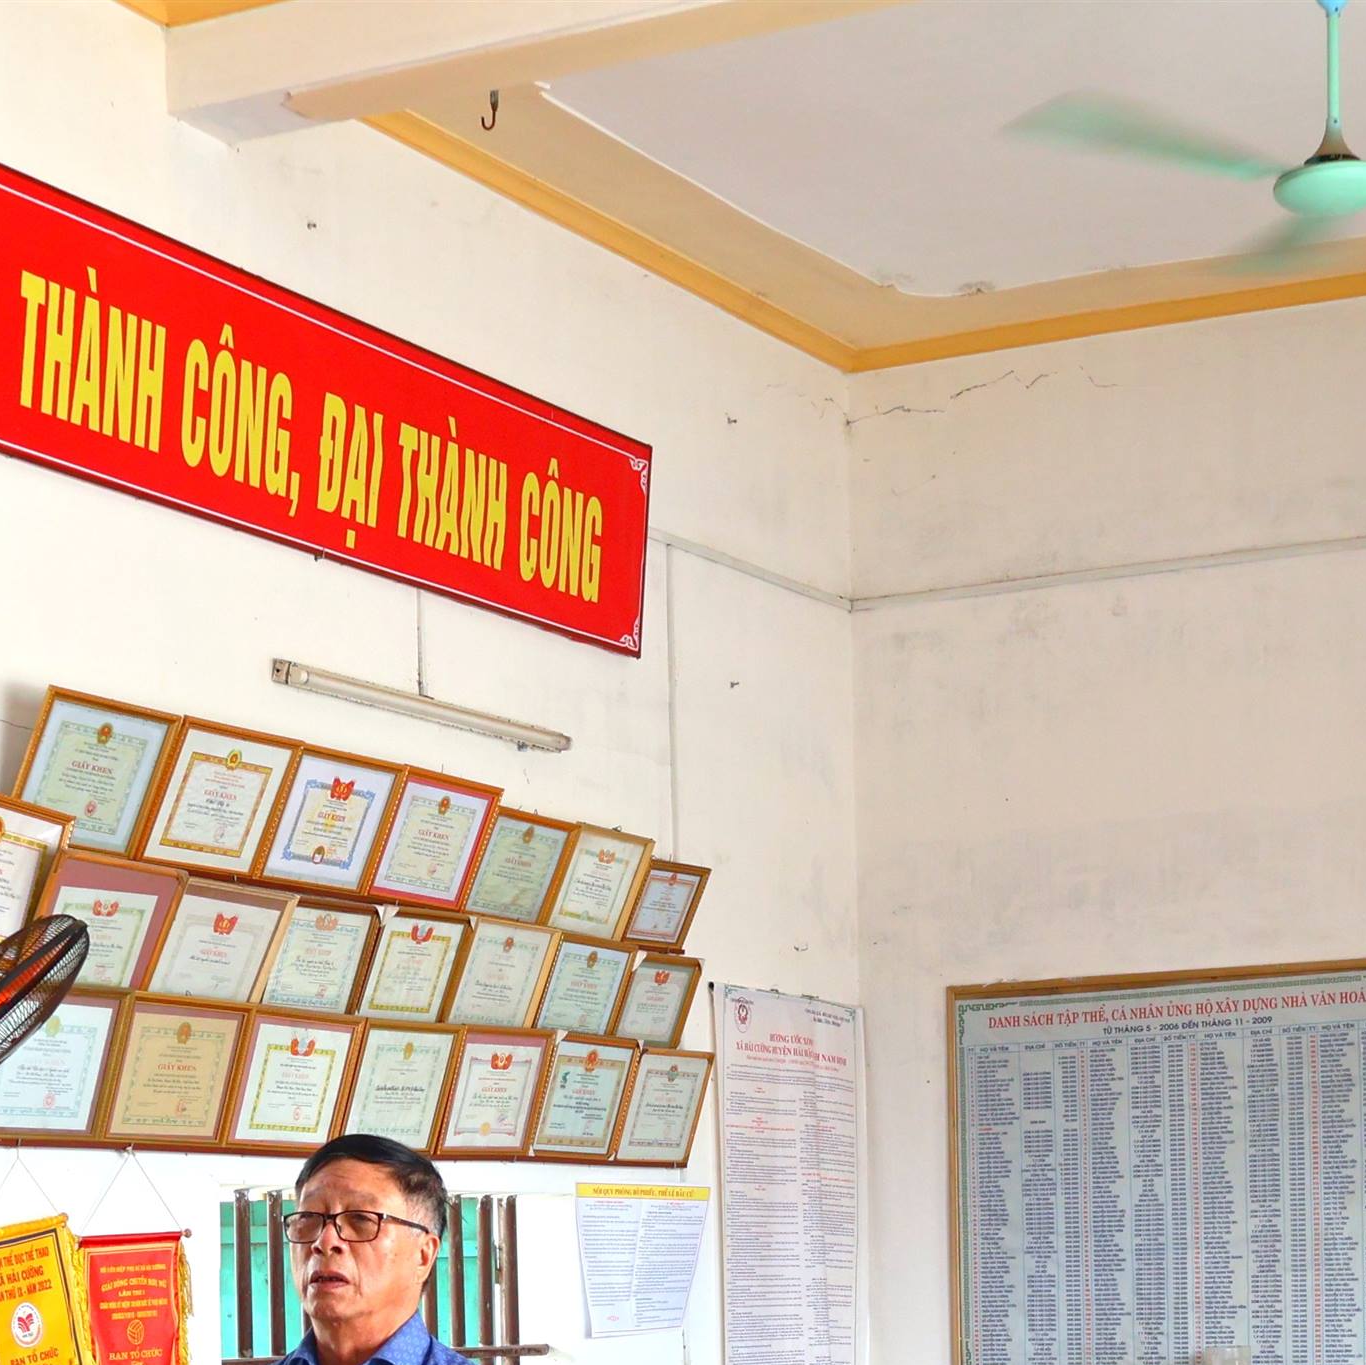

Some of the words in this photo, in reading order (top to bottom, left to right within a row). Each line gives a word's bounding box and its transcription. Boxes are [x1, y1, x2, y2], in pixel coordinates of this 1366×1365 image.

[20, 266, 166, 453] THÀNH
[181, 324, 302, 517] CÔNG,
[318, 392, 383, 550] ĐẠI
[397, 415, 507, 571] THÀNH
[519, 457, 603, 604] CÔNG
[988, 1015, 1021, 1029] DANH
[1023, 1011, 1054, 1027] SÁCH
[1057, 1008, 1080, 1028] TẬP
[1082, 1003, 1109, 1024] THỂ,
[1111, 1004, 1127, 1021] CÁ
[1130, 1003, 1164, 1020] NHÂN
[1166, 1000, 1192, 1018] ỦNG
[1196, 998, 1214, 1017] HỘ
[1215, 997, 1240, 1014] XÂY
[1242, 997, 1278, 1014] DỰNG
[1281, 991, 1308, 1009] NHÀ
[1339, 986, 1366, 1005] HOÁ
[1114, 1024, 1144, 1034] THÁNG
[1145, 1024, 1152, 1032] 5
[1159, 1022, 1180, 1032] 2006
[1181, 1020, 1199, 1030] ĐẾN
[1201, 1018, 1232, 1028] THÁNG
[1235, 1018, 1243, 1026] 11
[1251, 1015, 1273, 1025] 2009
[6, 1269, 21, 1284] HẢI
[21, 1265, 44, 1281] CƯỜNG
[37, 1278, 54, 1292] 2022
[27, 1348, 38, 1364] TỔ
[39, 1346, 59, 1361] CHỨC
[109, 1351, 129, 1361] BAN
[129, 1346, 141, 1360] TỔ
[140, 1347, 163, 1359] CHỨC
